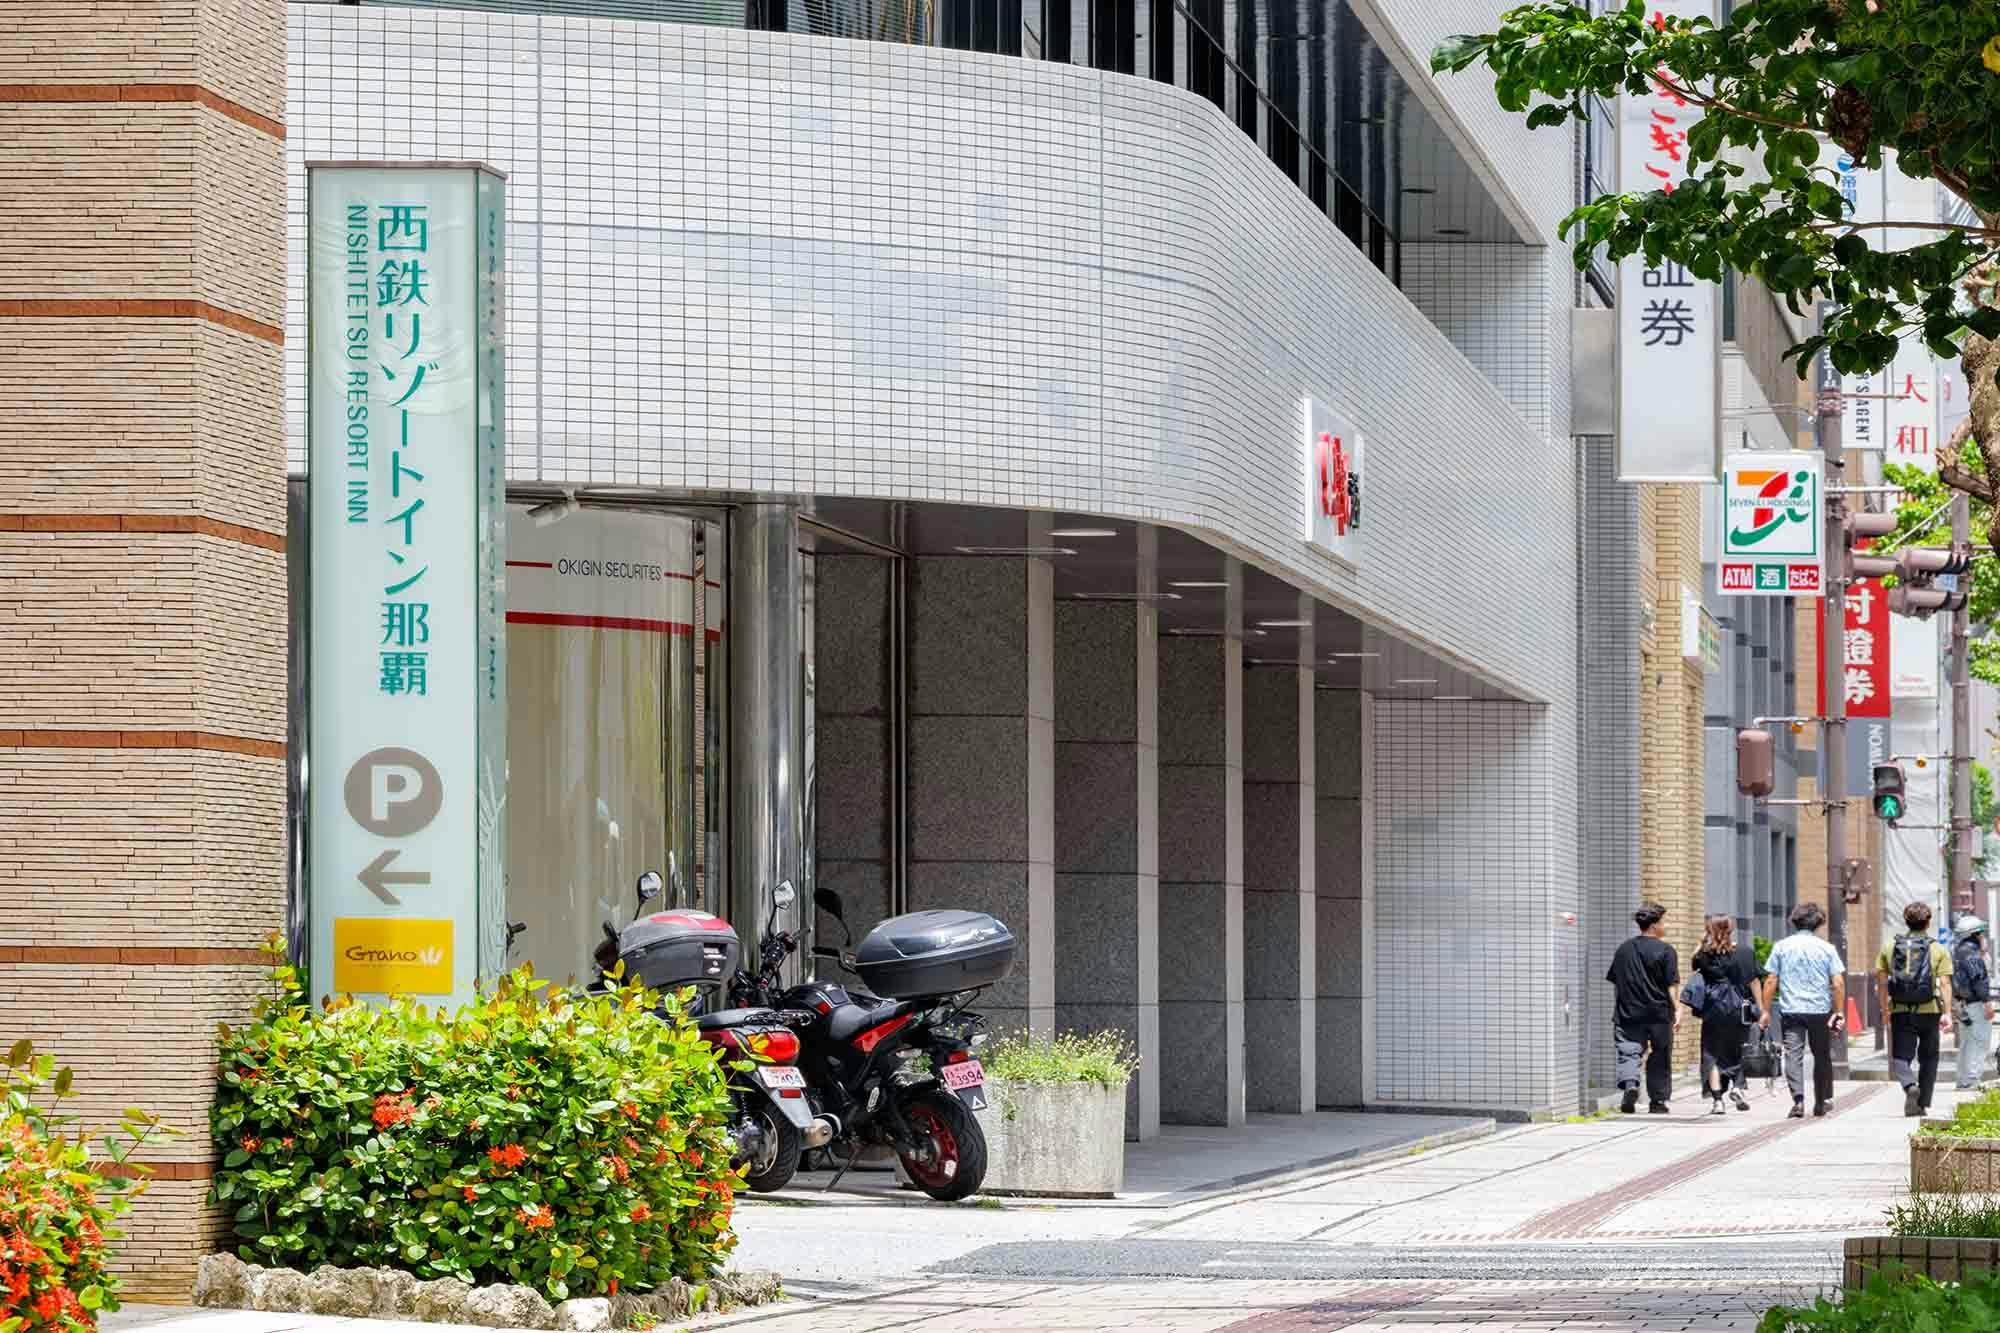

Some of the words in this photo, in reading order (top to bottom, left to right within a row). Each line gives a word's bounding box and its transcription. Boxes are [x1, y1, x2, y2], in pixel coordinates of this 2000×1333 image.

[347, 205, 368, 361] NISHITETSU
[347, 371, 368, 471] RESORT
[1856, 401, 1870, 442] AGENT
[376, 205, 438, 696] 西鉄リゾートイン那覇
[347, 481, 368, 523] INN
[558, 559, 601, 576] OKIGIN
[1724, 567, 1752, 586] ATM
[1761, 568, 1779, 586] 酒
[1789, 568, 1818, 586] たばこ
[371, 764, 423, 821] P
[345, 945, 417, 961] Grano
